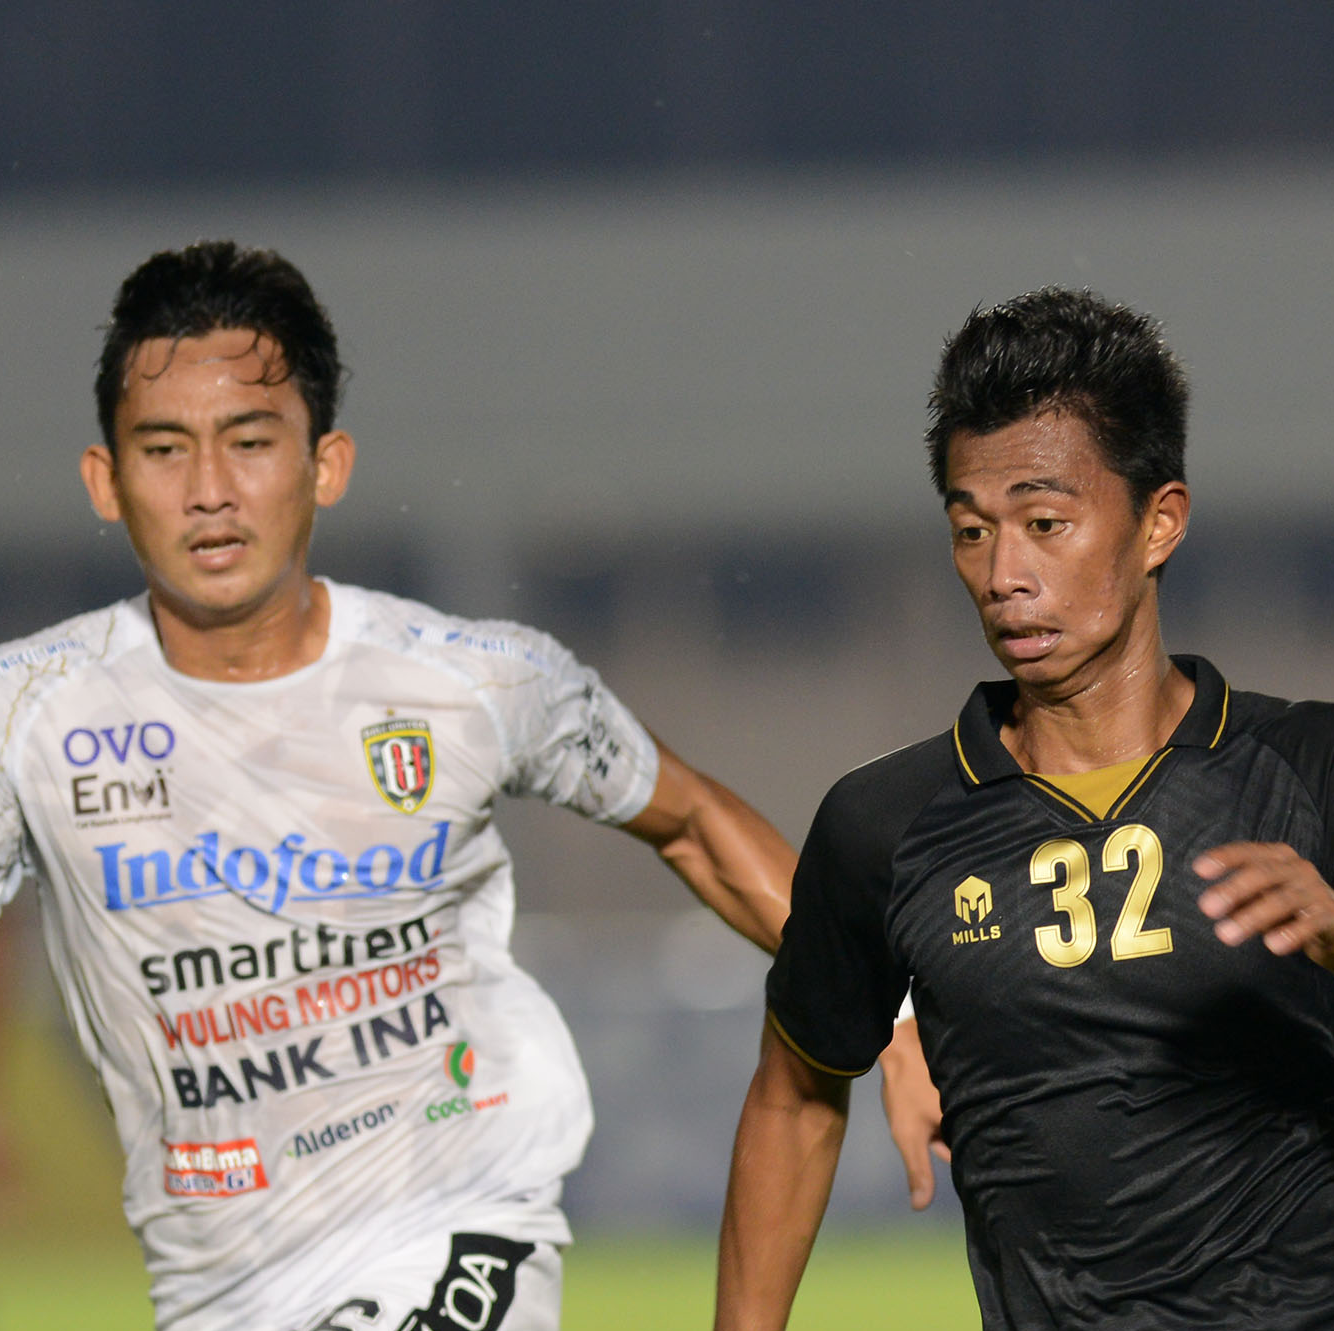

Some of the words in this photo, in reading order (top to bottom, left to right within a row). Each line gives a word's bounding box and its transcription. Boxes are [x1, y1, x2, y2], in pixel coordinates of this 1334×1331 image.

[63, 721, 175, 767] OVO
[93, 821, 452, 914] Indofood
[1029, 824, 1173, 968] 32
[952, 924, 1002, 945] MILLS
[295, 948, 441, 1025] MOTORS
[171, 1036, 335, 1109] BANK
[350, 992, 450, 1067] INA
[293, 1103, 394, 1158] Alderon
